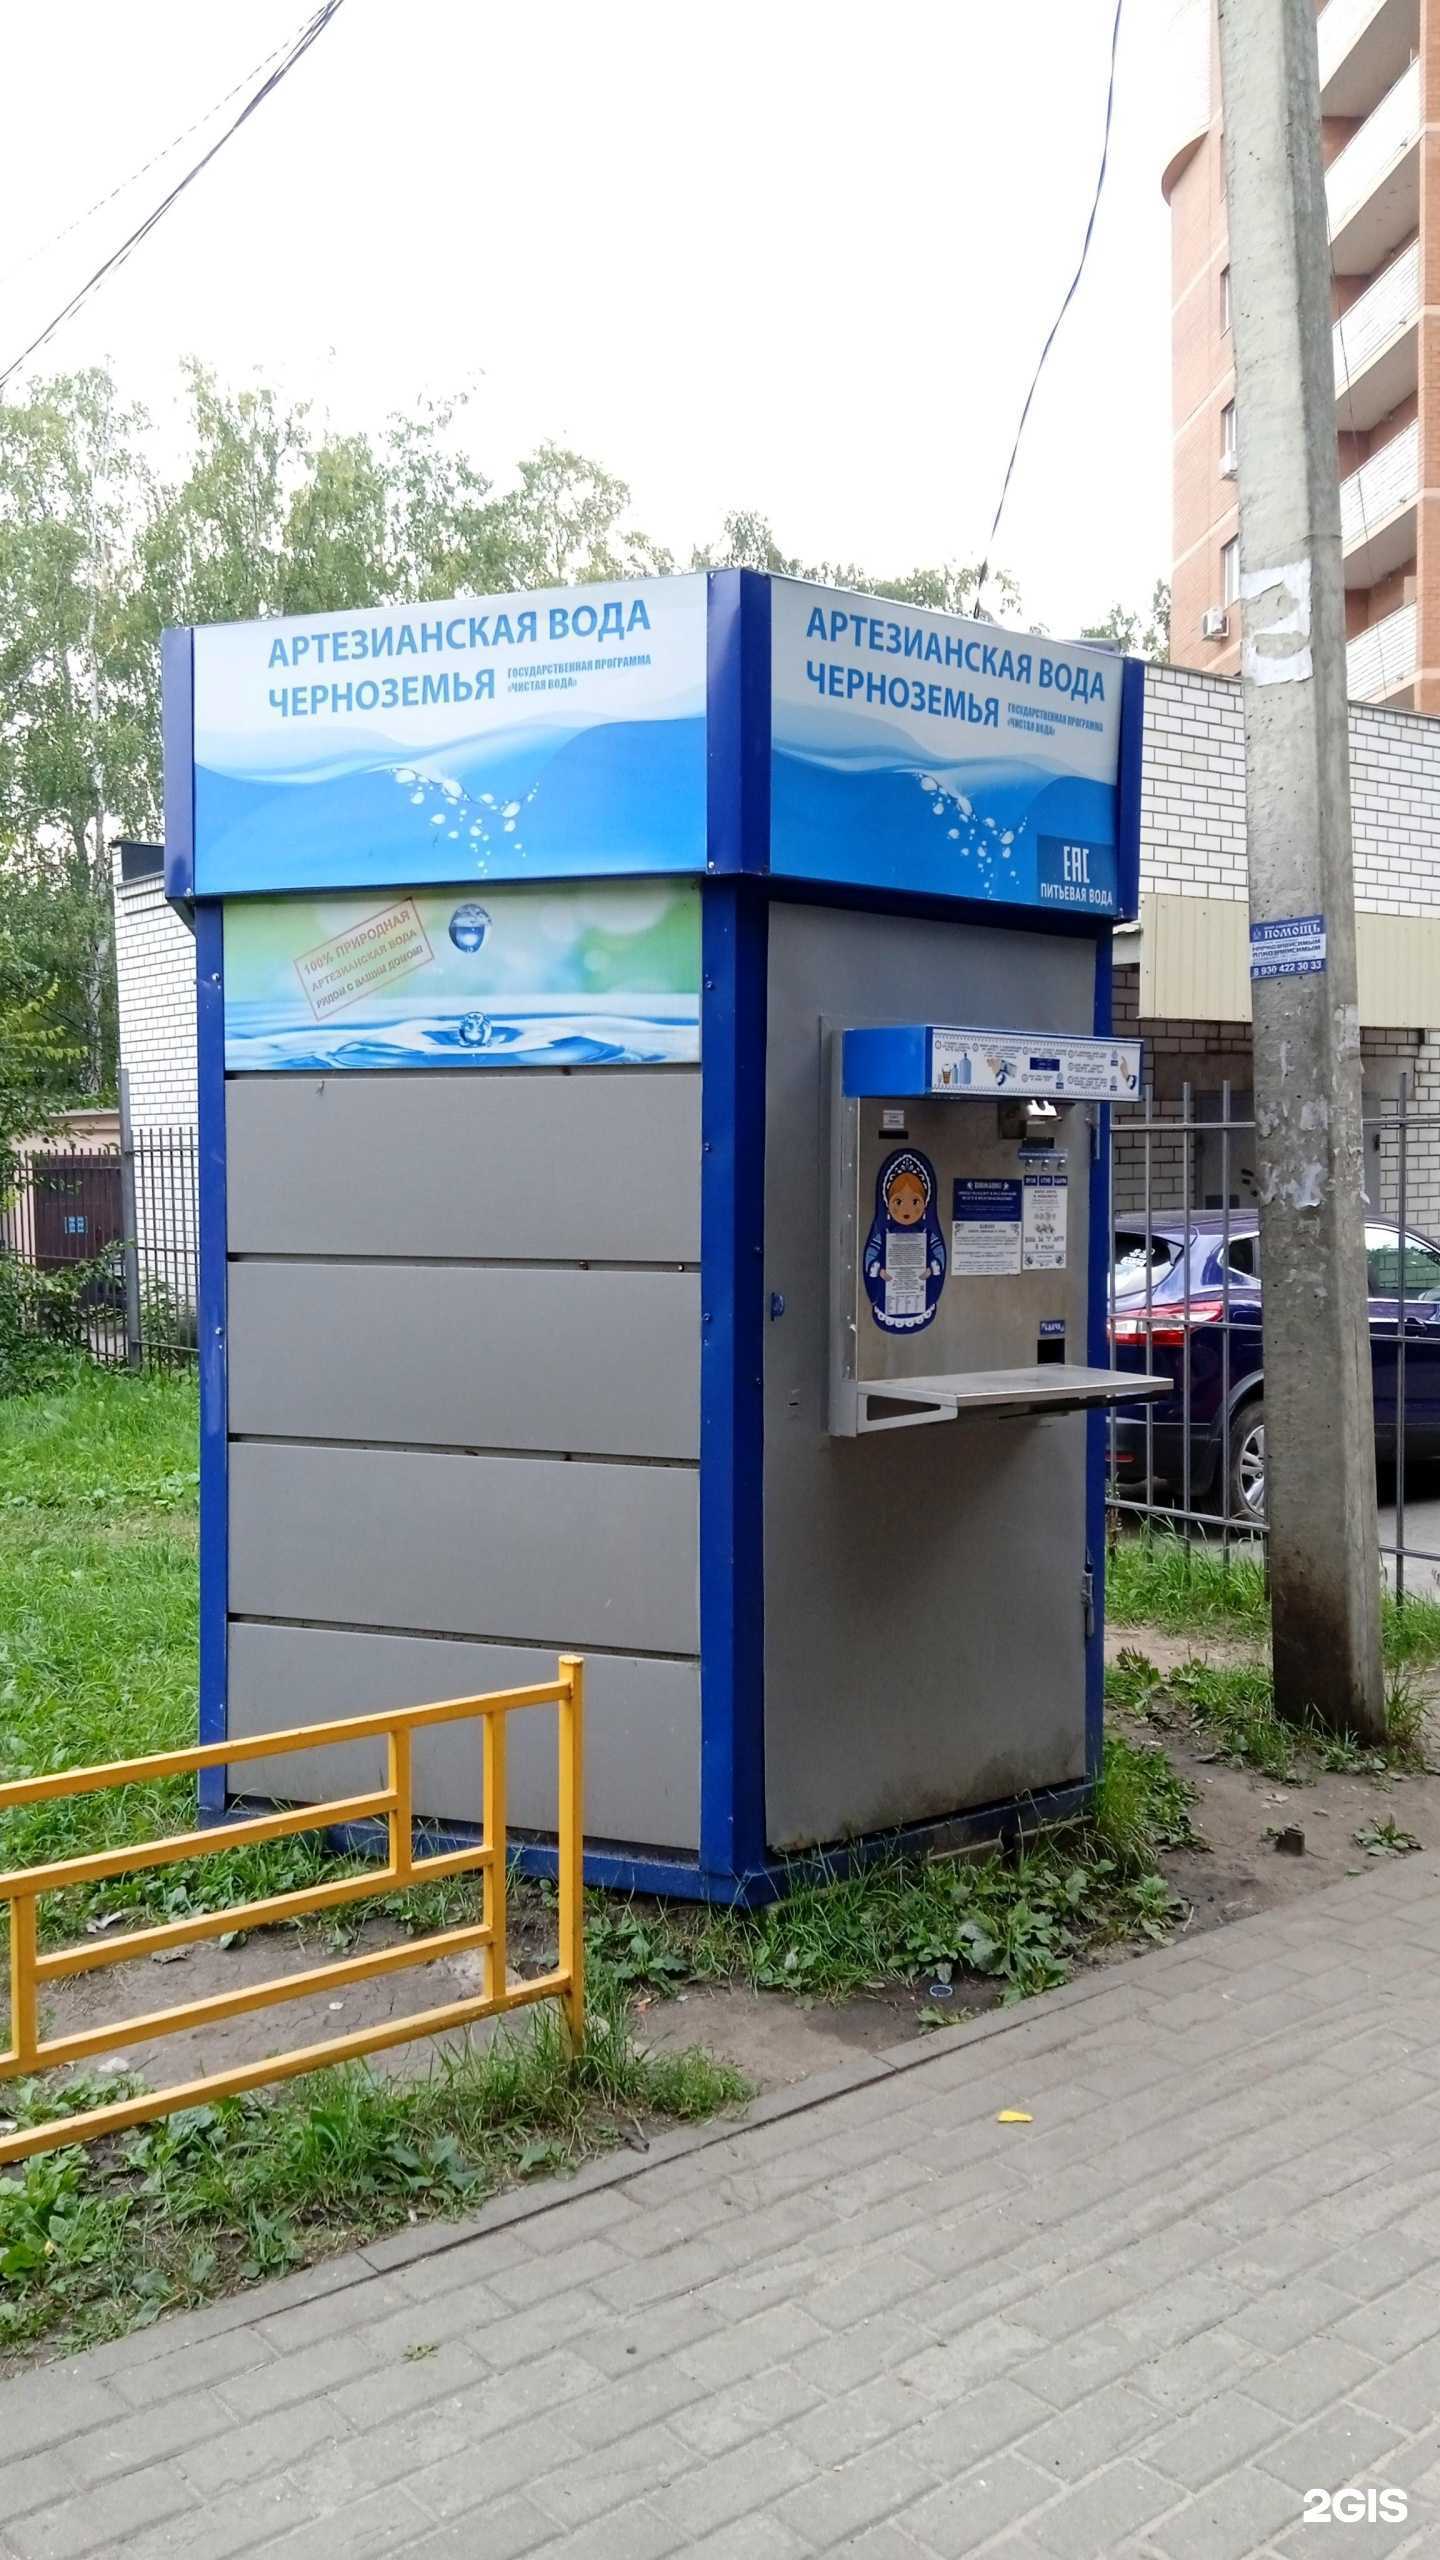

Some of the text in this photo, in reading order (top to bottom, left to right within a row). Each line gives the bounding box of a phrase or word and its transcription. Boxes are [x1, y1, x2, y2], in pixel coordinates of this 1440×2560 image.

[267, 599, 651, 668] АРТЕЗИАНСКАЯ ВОДА
[507, 654, 651, 679] ГОСУДАРСТВЕННАЯ ПРОГРАММА
[806, 606, 1105, 704] АРТЕЗИАНСКАЯ ВОДА
[268, 668, 496, 718] ЧЕРНОЗЕМЬЯ
[806, 660, 999, 728] ЧЕРНОЗЕМЬЯ
[1007, 702, 1067, 725] ГОСУДАРСТВЕННАЯ
[1040, 883, 1113, 906] ПИТЬЕВАЯ ВОДА
[303, 909, 411, 975] 100% ПРИРОДНАЯ
[1264, 924, 1320, 939] ПОМОЩЬ
[312, 928, 417, 992] АРТЕЗИАНСКАЯ ВОДА
[1254, 968, 1259, 976] 8
[1279, 963, 1295, 972] 422
[1311, 960, 1322, 969] 33
[347, 981, 354, 992] С
